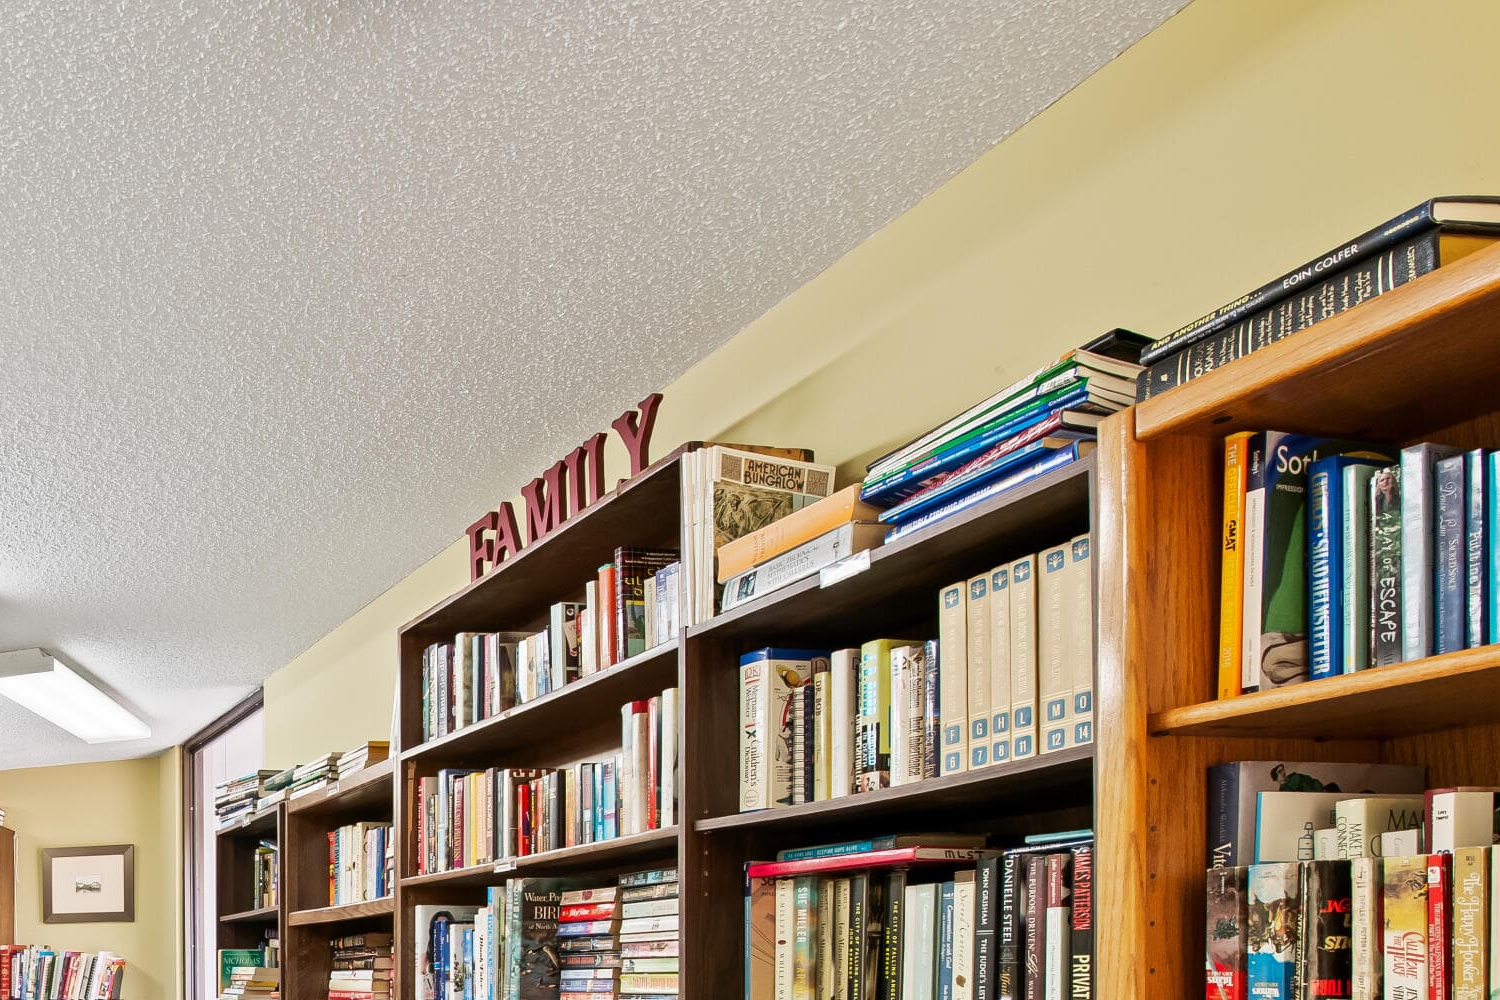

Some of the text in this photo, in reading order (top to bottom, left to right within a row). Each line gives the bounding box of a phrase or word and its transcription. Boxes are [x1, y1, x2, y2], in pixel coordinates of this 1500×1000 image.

[1282, 244, 1358, 290] EOIN COLFER
[1151, 312, 1216, 350] AND ANOTHER
[466, 393, 663, 583] FAMILY
[744, 471, 805, 490] BUNGALOW
[748, 460, 801, 479] AMERICAN
[1225, 445, 1236, 551] THE GMAT
[1313, 540, 1329, 675] SHAD HELMSTETTER
[1379, 577, 1396, 643] ESCAPE
[750, 740, 760, 786] Children's
[1073, 852, 1089, 880] JAMES
[797, 887, 807, 942] SUE MILLER
[981, 890, 989, 925] GRISHAM
[1003, 860, 1014, 944] DANIELLE STEEL
[1028, 879, 1036, 914] PURPOSE
[1074, 882, 1090, 930] PATTERSON
[1456, 873, 1481, 983] The Happy Hooker
[223, 957, 261, 965] NICHOLAS
[978, 956, 987, 983] JUDGE'S
